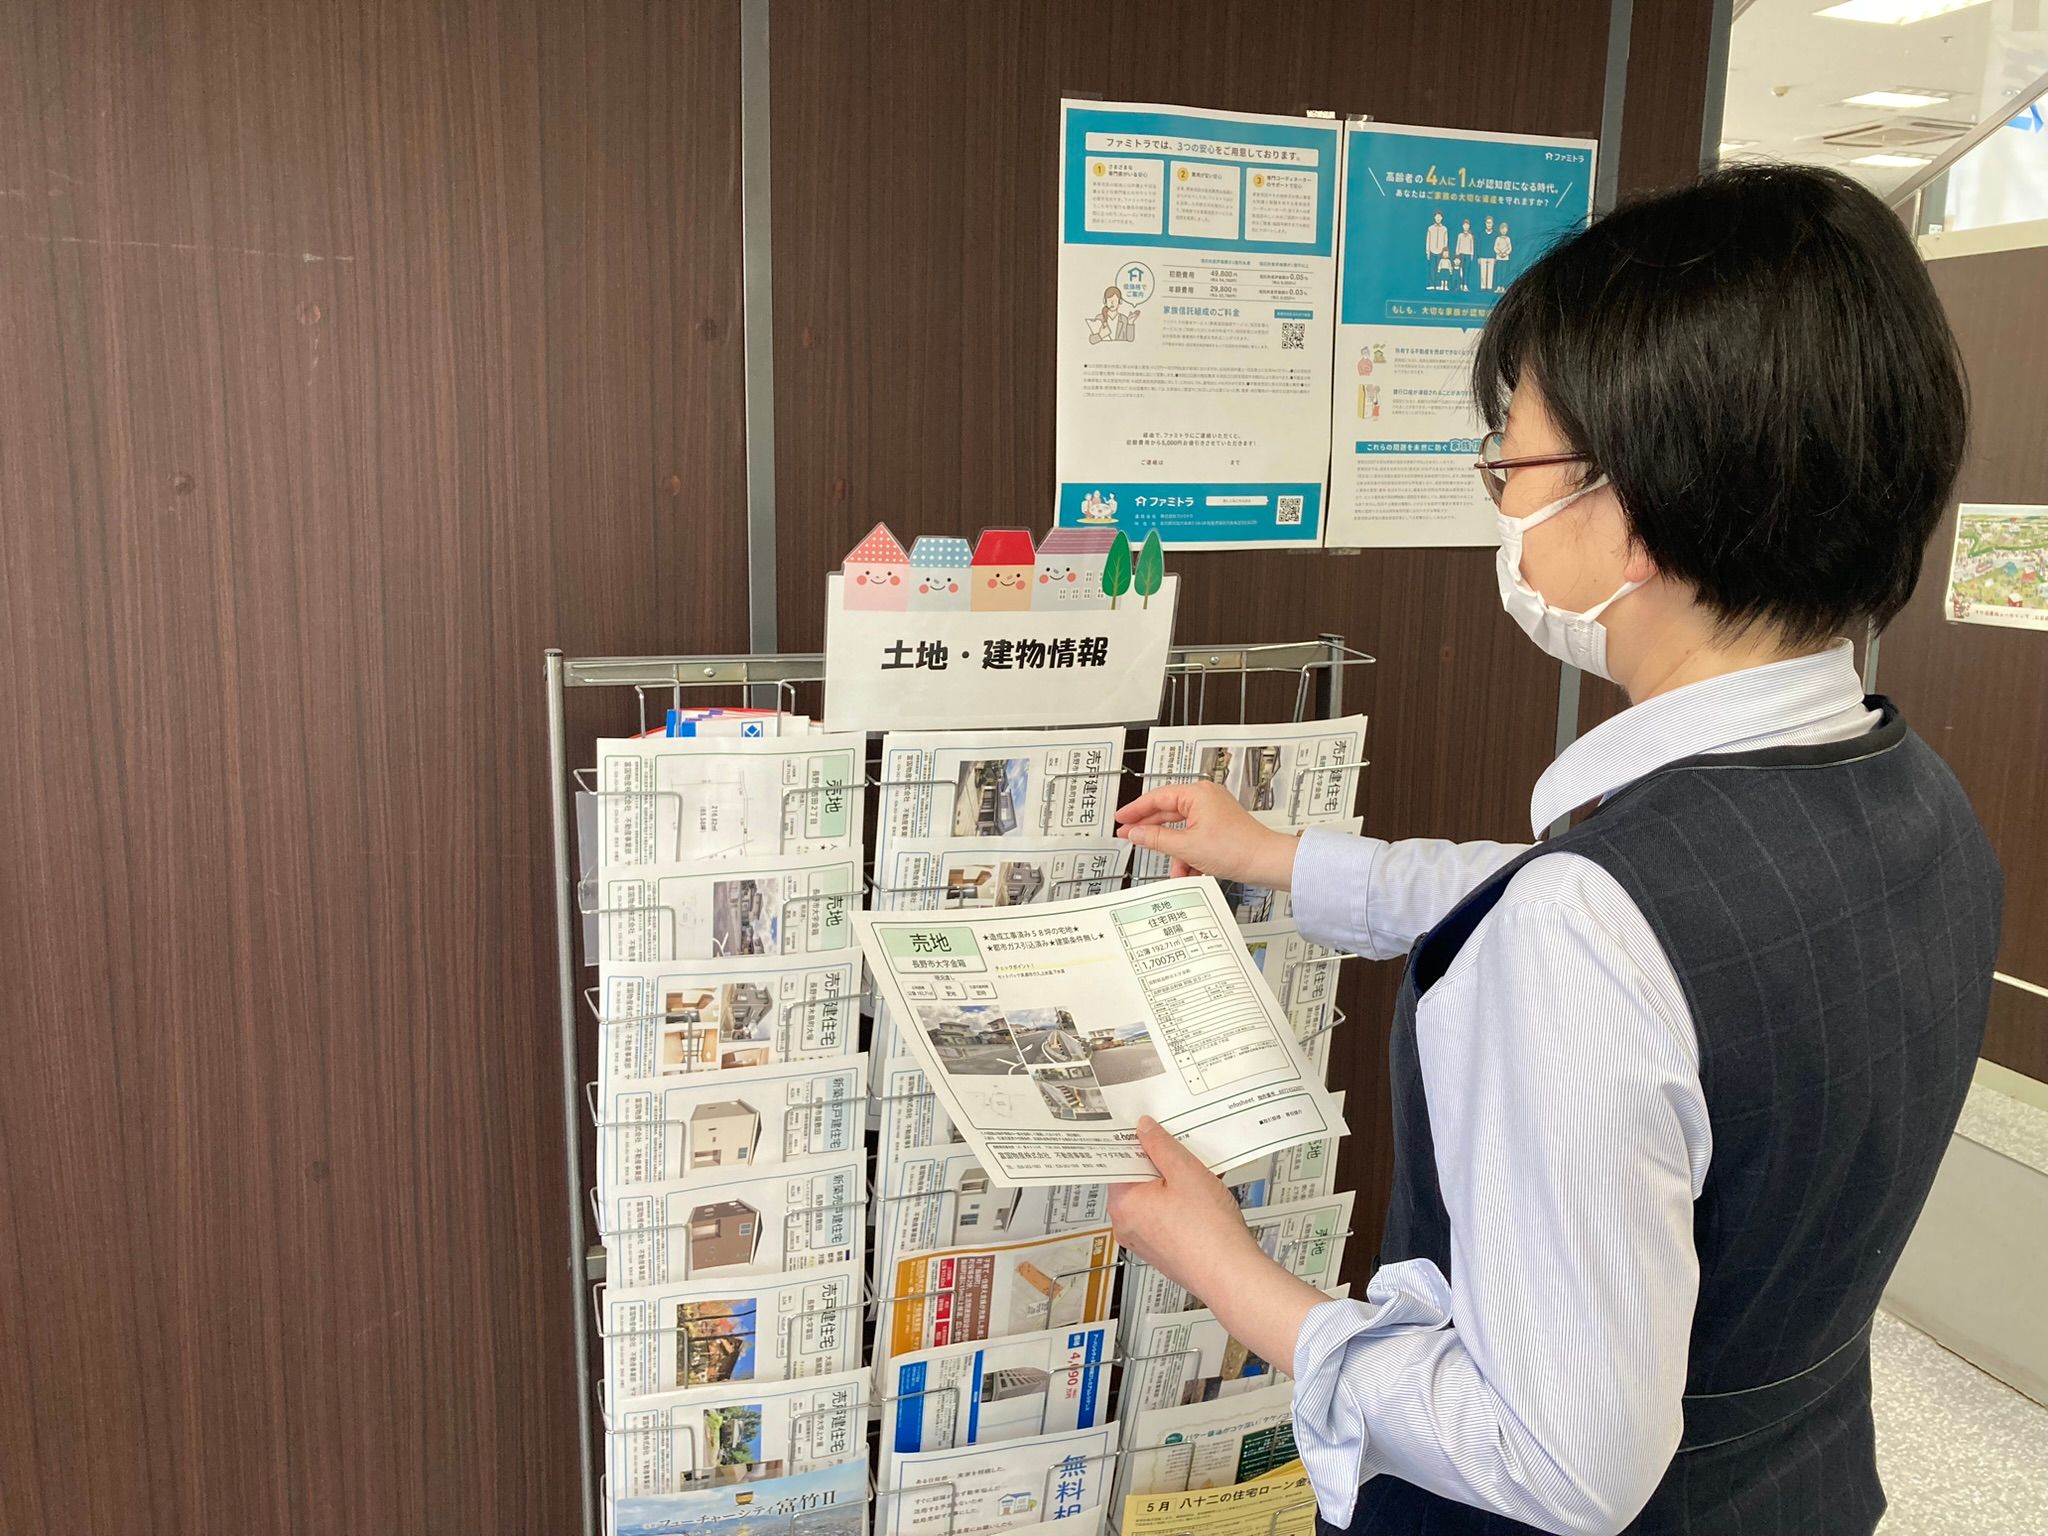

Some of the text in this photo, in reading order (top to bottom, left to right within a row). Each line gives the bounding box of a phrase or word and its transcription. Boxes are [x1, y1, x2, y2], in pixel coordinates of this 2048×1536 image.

[1554, 153, 1584, 163] ファミトラ
[1149, 496, 1194, 507] ファミトラ
[881, 636, 1109, 671] 土地・建物情報
[1080, 750, 1102, 823] 売戸建住宅
[1324, 740, 1347, 812] 売戸建住宅
[825, 779, 843, 814] 売地
[826, 896, 844, 927] 売地
[1152, 900, 1172, 914] 売地
[1148, 911, 1188, 928] 住宅用地
[1163, 925, 1184, 938] 朝陽
[1199, 929, 1219, 941] なし
[909, 932, 952, 953] 売地
[1135, 948, 1152, 958] 公簿
[911, 958, 967, 969] 長野市大字金箱
[1142, 949, 1187, 971] 1,700万円
[820, 971, 841, 1046] 売戸建住宅
[819, 1283, 838, 1349] 売戸建住宅
[830, 1390, 848, 1453] 売戸建住宅
[1146, 1501, 1170, 1512] 5月
